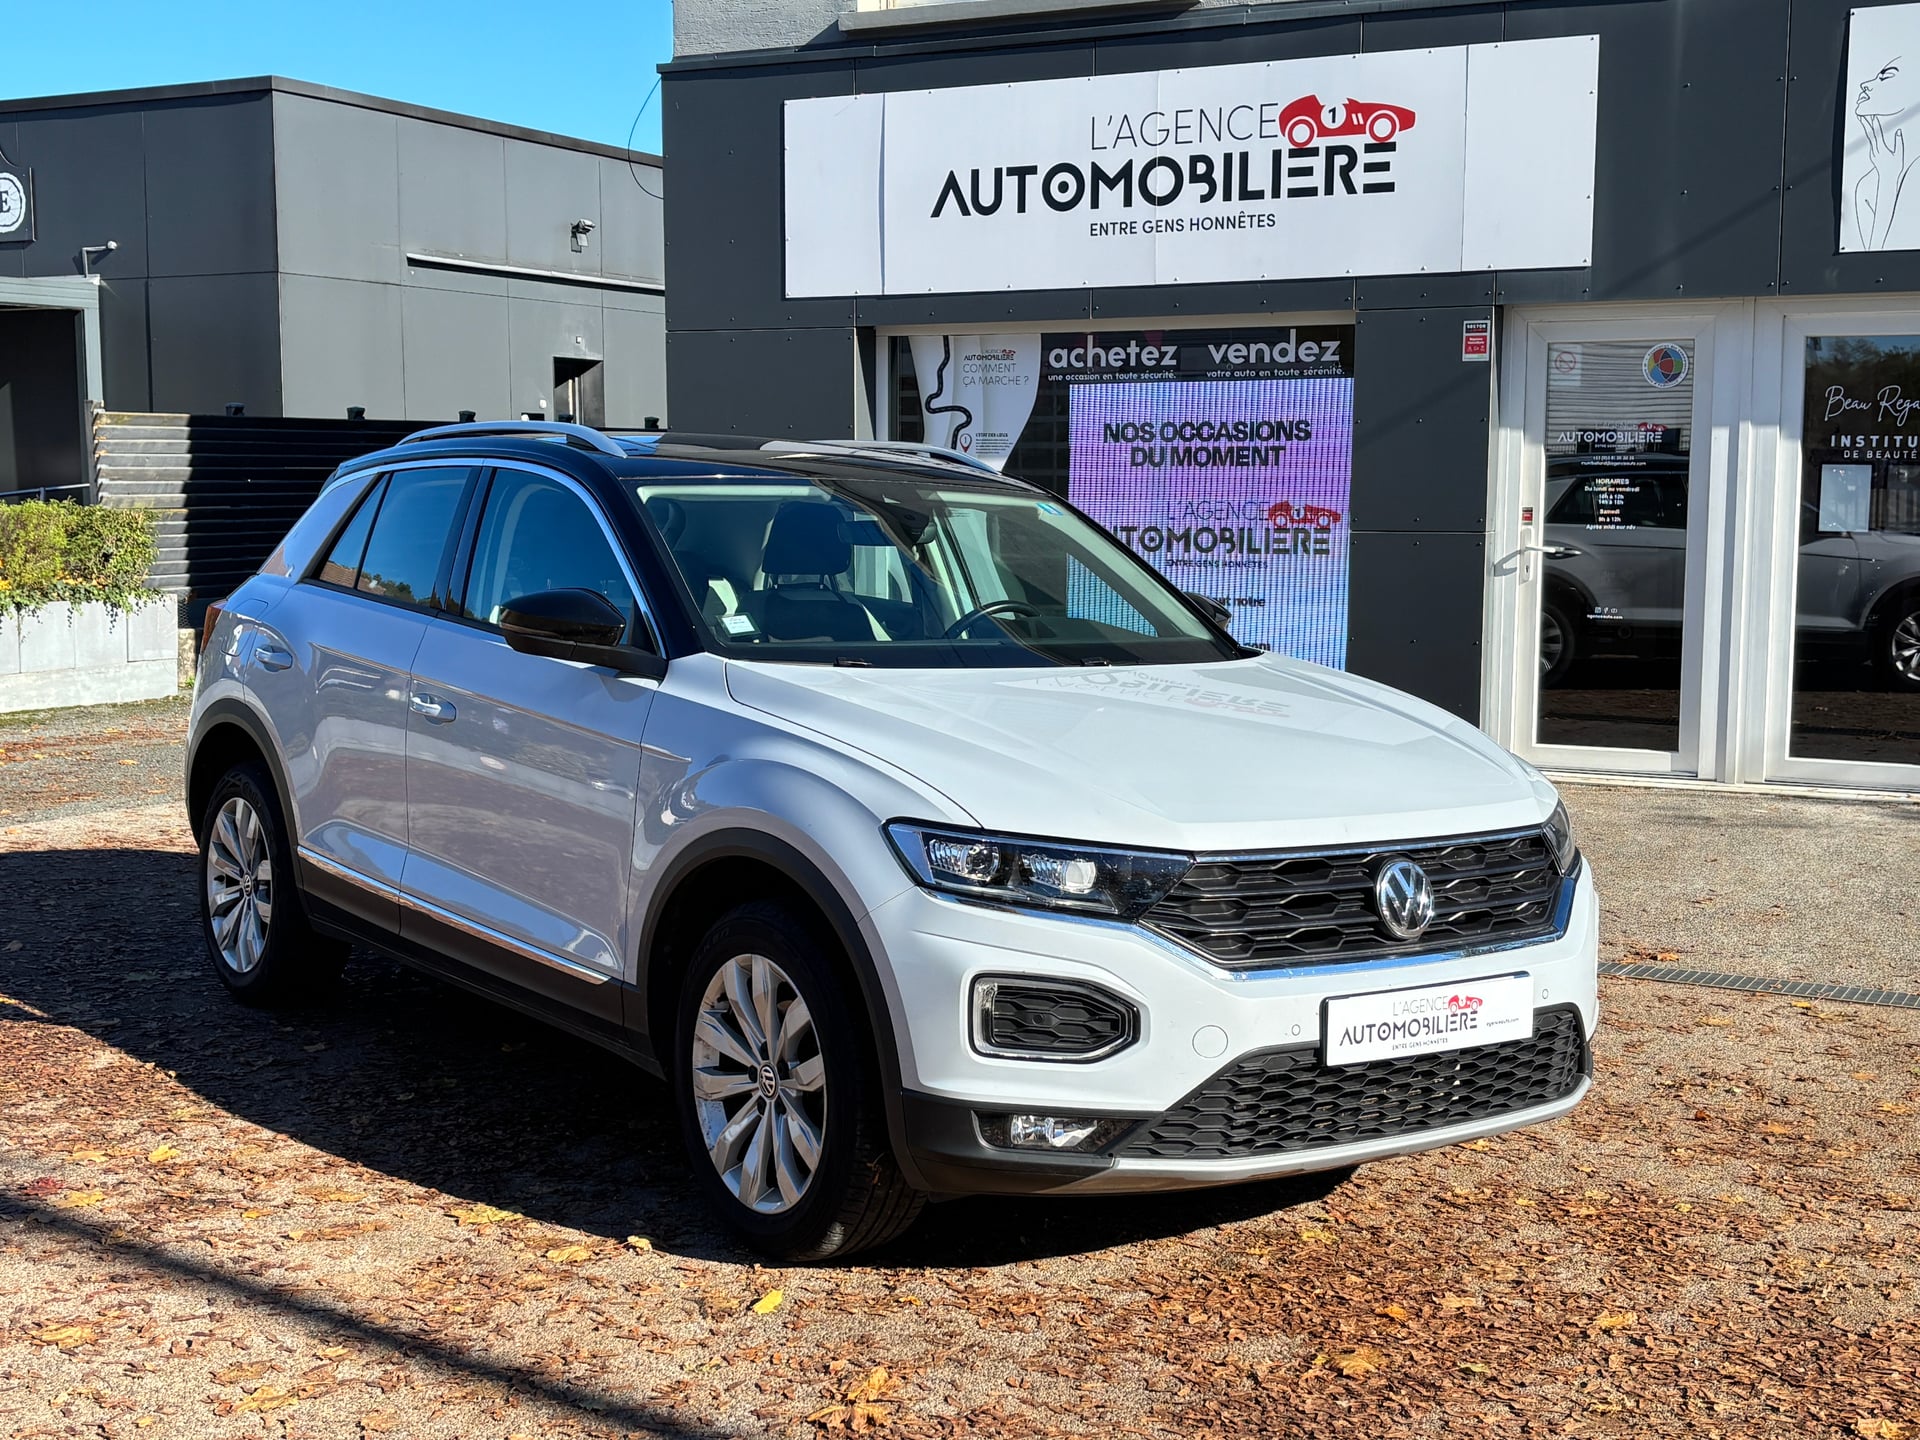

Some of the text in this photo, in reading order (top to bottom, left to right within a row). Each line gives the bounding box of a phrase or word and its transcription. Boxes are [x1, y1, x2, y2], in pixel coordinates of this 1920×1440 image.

[1091, 103, 1279, 150] L'AGENCE
[1090, 211, 1276, 237] ENTRE GENS HONNÊTES
[1048, 335, 1178, 368] achetez
[1207, 328, 1341, 364] vendez
[962, 363, 1017, 374] COMMENT
[1065, 371, 1100, 381] occasion
[1115, 372, 1138, 380] toute
[1140, 370, 1177, 379] sécurité.
[1206, 369, 1231, 378] votre
[1234, 369, 1256, 377] auto
[1274, 368, 1300, 376] toute
[1303, 365, 1345, 376] sérénité.
[962, 375, 1030, 387] ÇA MARCHE ?
[1825, 385, 1872, 422] Beau
[1103, 420, 1312, 443] NOS OCCASIONS
[1130, 446, 1286, 468] DU MOMENT
[1844, 449, 1918, 459] DE BEAUTÉ
[1167, 500, 1270, 521] L'AGENCE
[1393, 996, 1449, 1017] L'AGENCE
